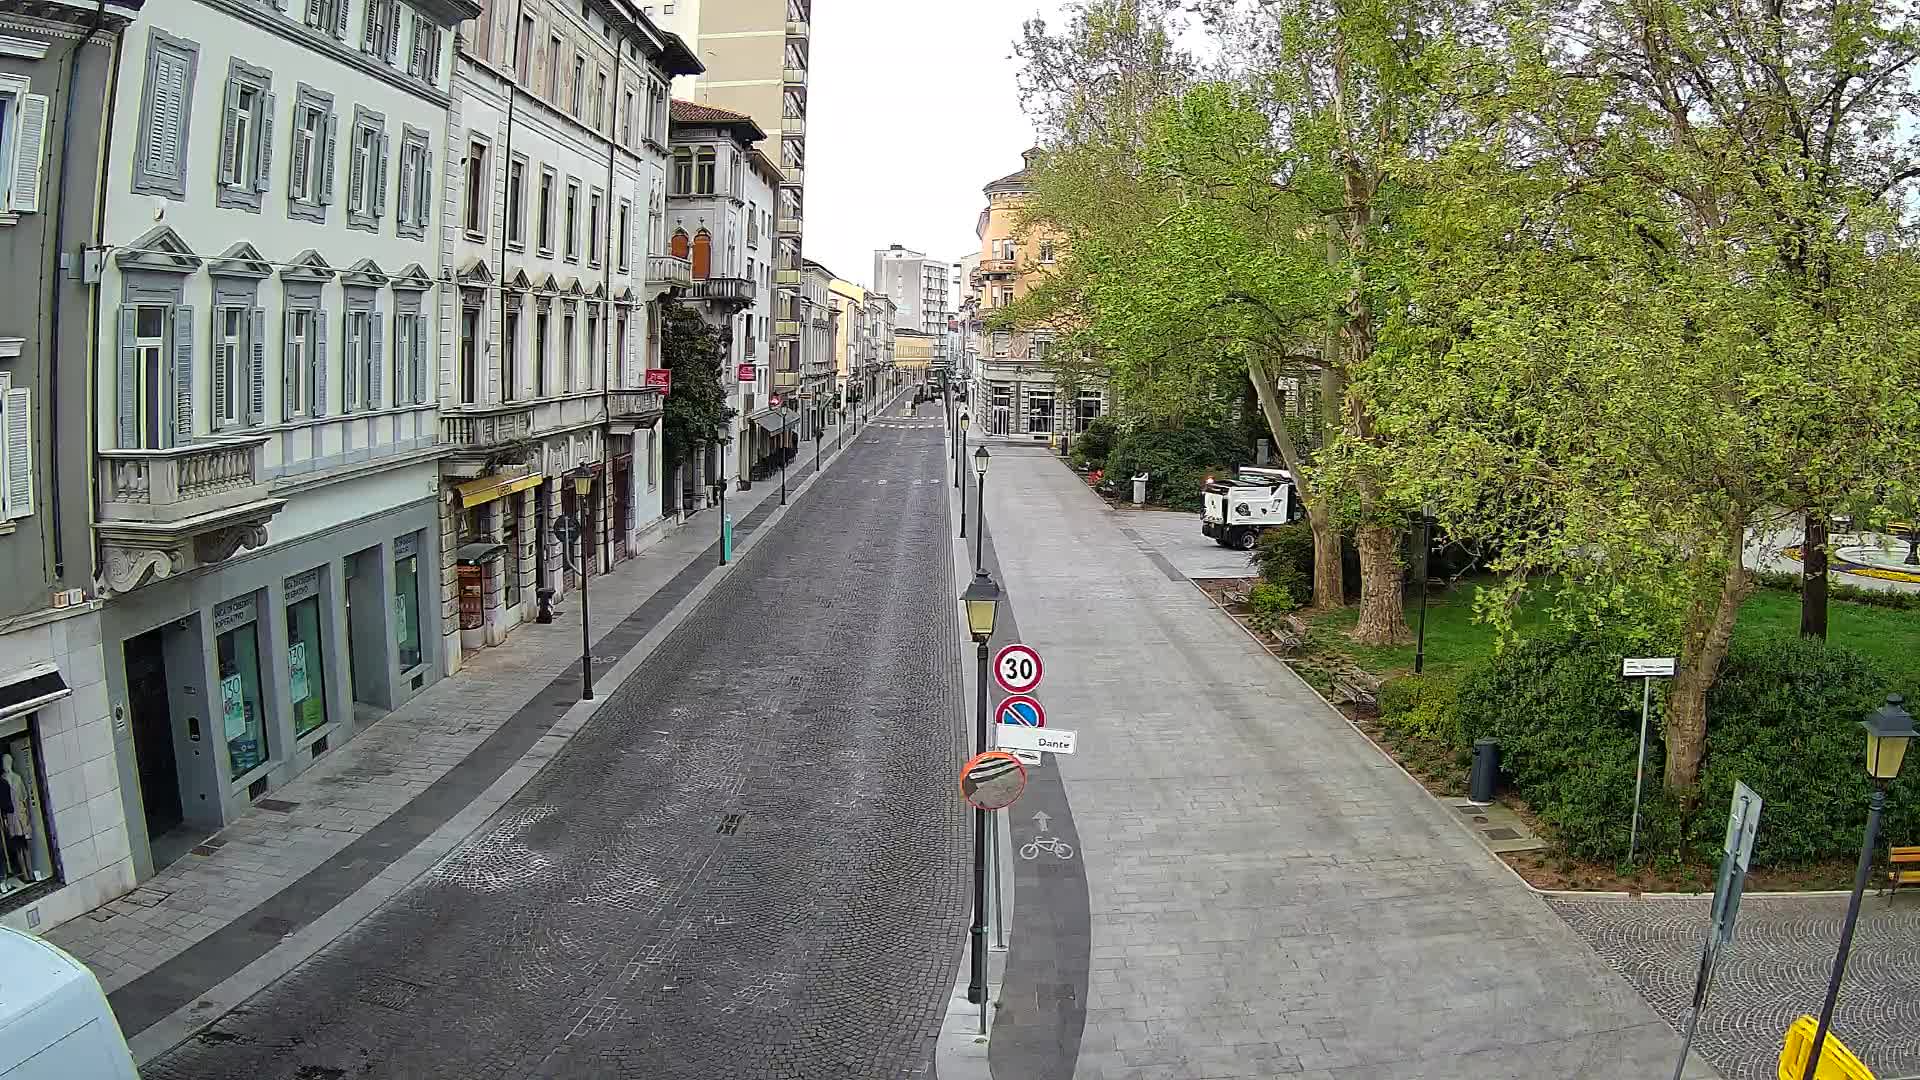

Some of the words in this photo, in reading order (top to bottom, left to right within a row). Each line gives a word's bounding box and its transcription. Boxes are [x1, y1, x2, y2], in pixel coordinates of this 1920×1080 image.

[1005, 658, 1033, 680] 30
[223, 677, 240, 700] 130
[1038, 738, 1070, 749] Dante
